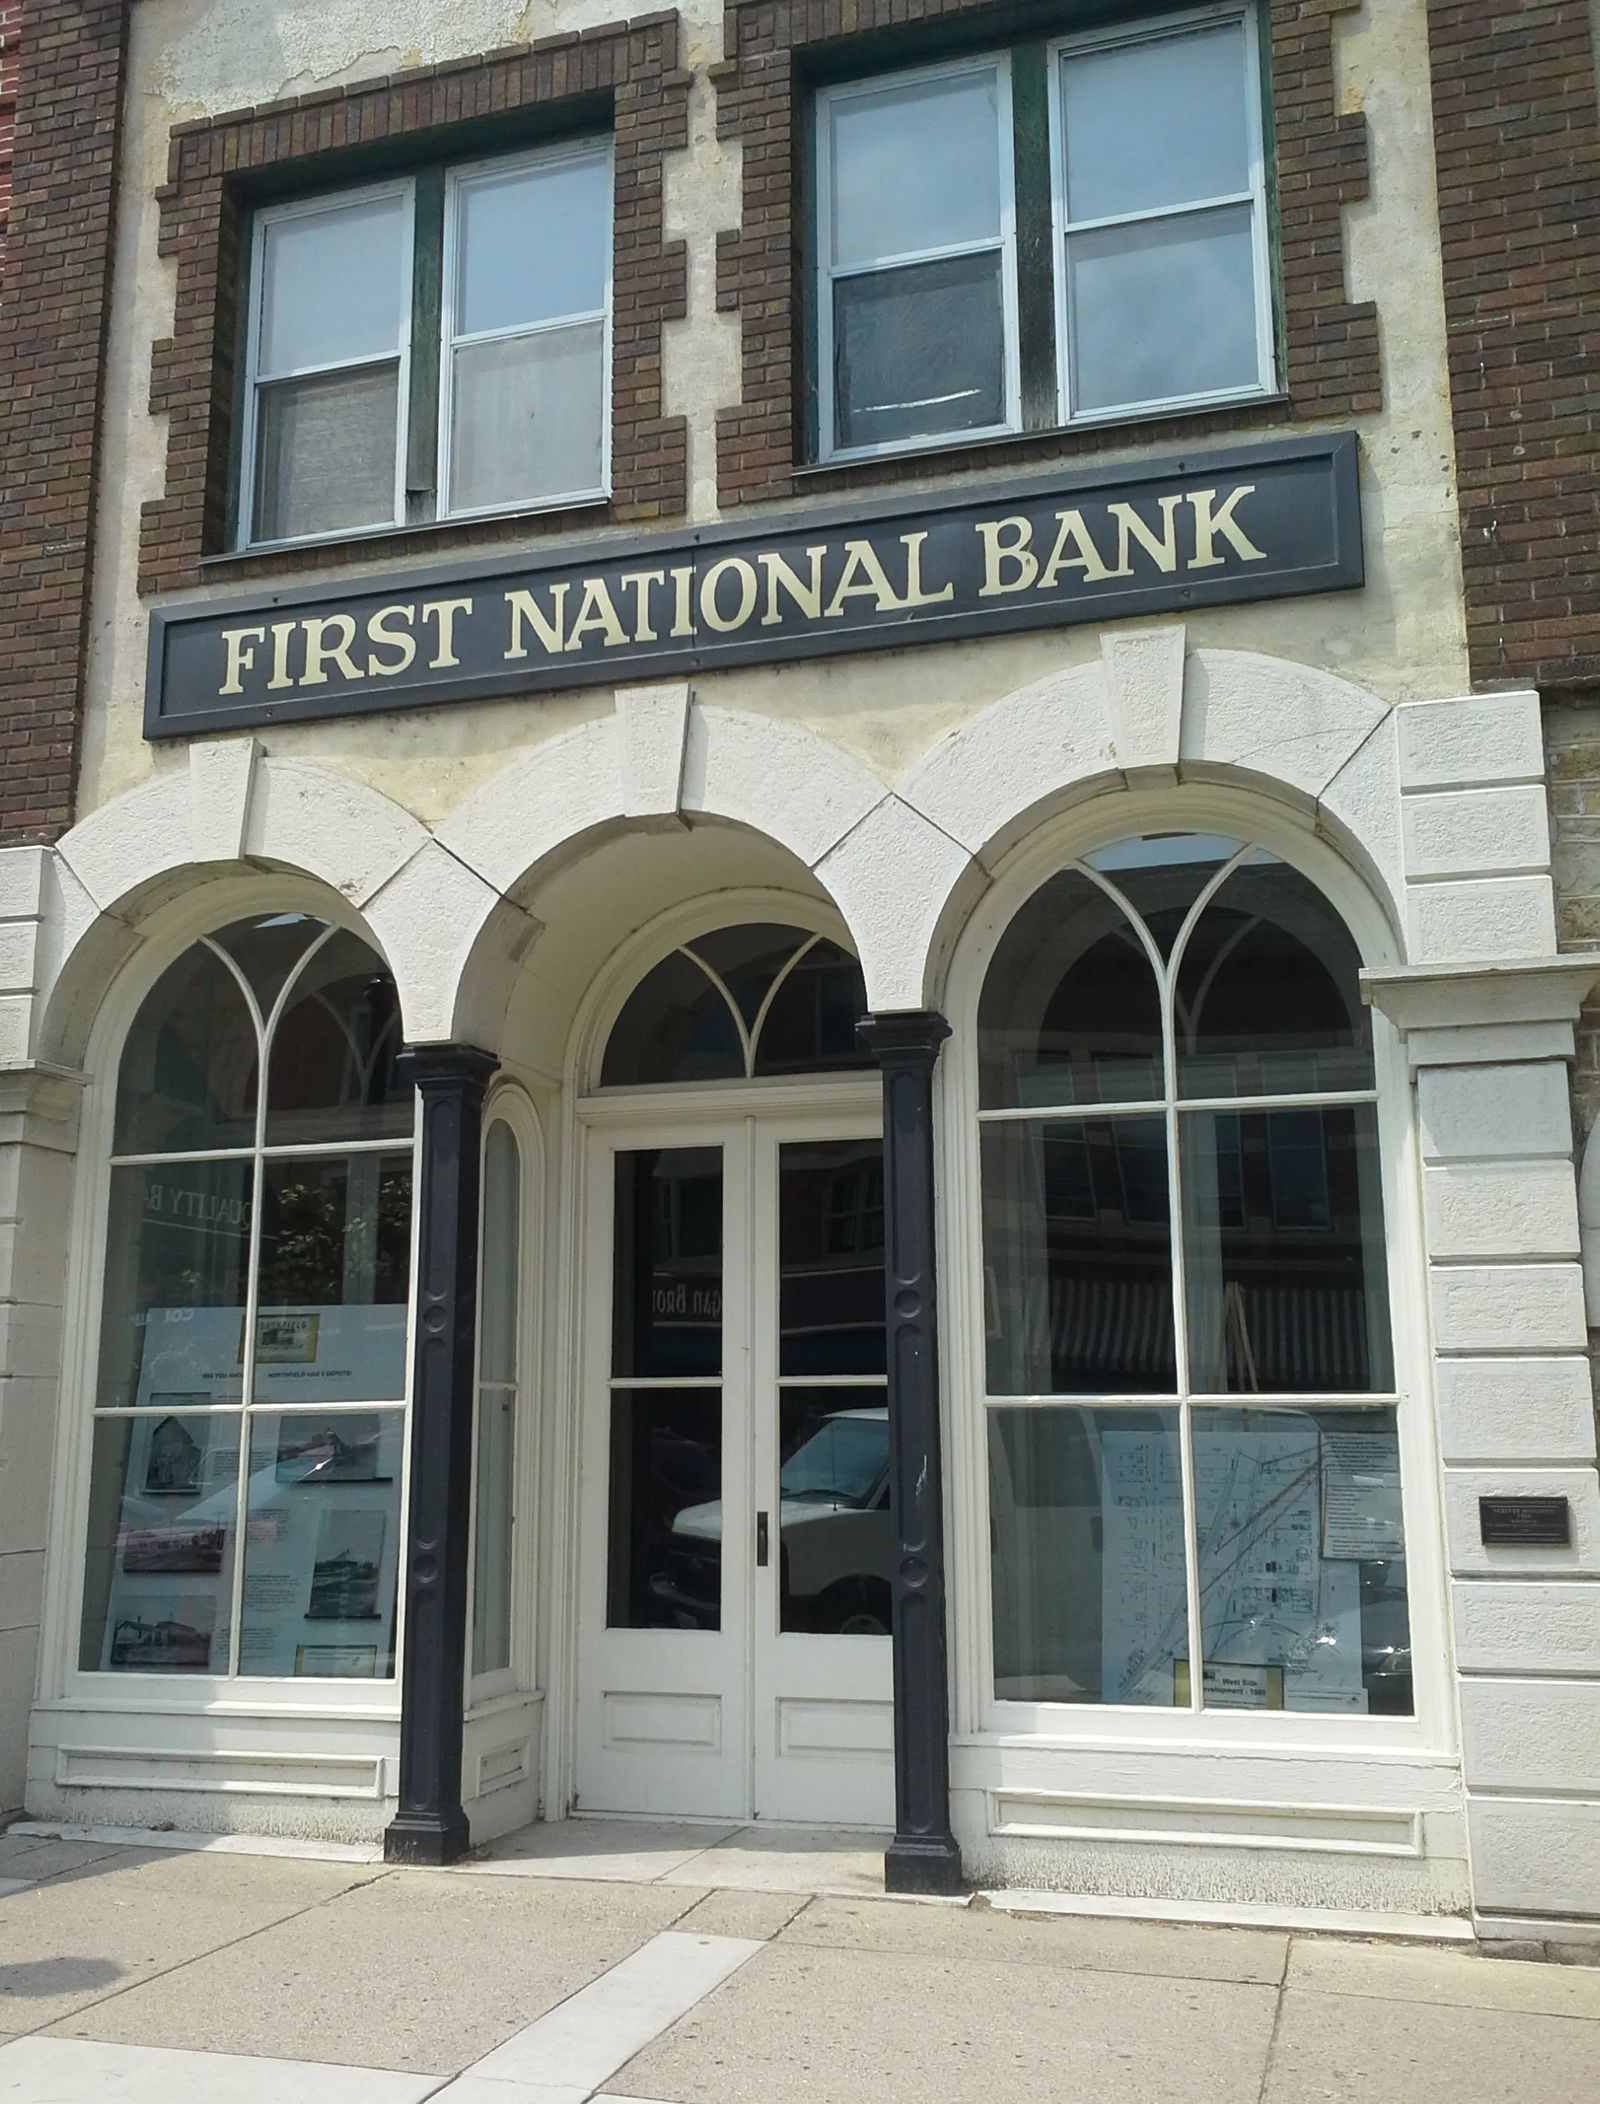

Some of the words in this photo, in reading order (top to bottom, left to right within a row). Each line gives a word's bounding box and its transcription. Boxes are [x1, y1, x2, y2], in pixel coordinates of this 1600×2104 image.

[219, 598, 473, 695] FIRST
[503, 531, 954, 660] NATIONAL
[975, 485, 1267, 598] BANK
[1222, 1678, 1241, 1686] West
[1242, 1679, 1258, 1687] Side
